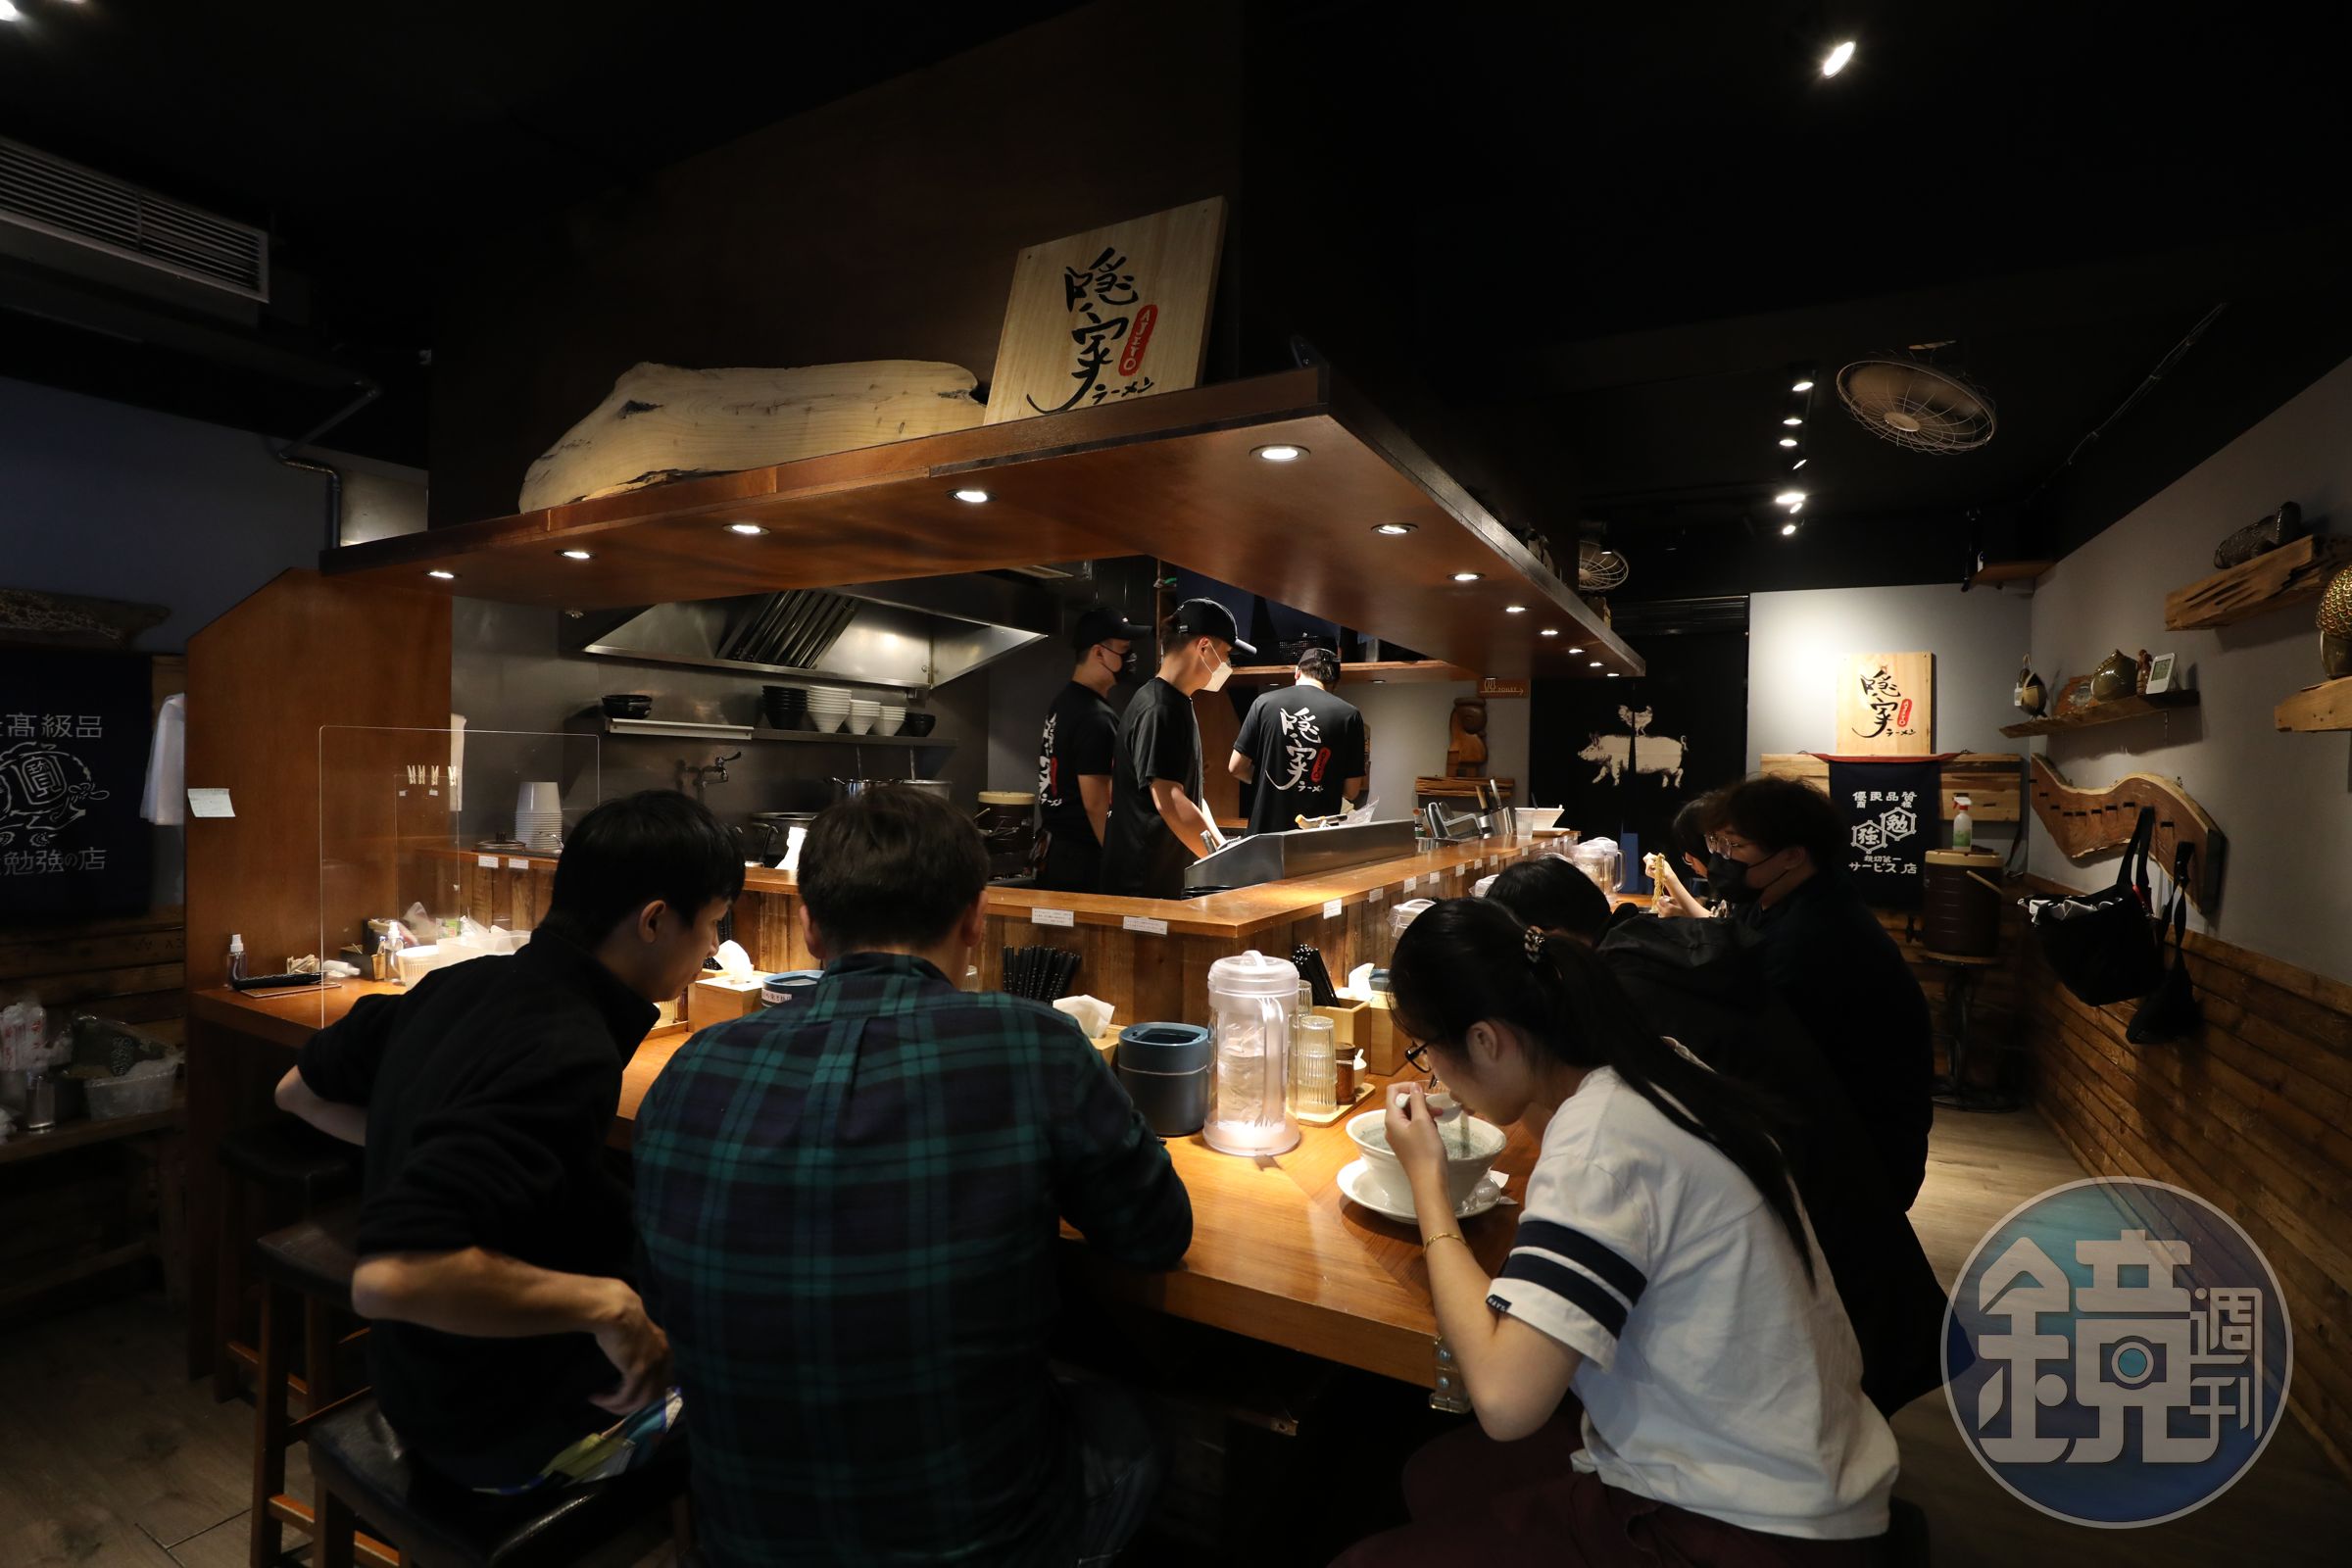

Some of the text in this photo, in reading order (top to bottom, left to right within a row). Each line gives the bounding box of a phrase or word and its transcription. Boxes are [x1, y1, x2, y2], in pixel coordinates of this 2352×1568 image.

[1122, 309, 1152, 371] AJITO
[1092, 376, 1154, 405] ラーメン
[0, 846, 108, 876] 勉強の店
